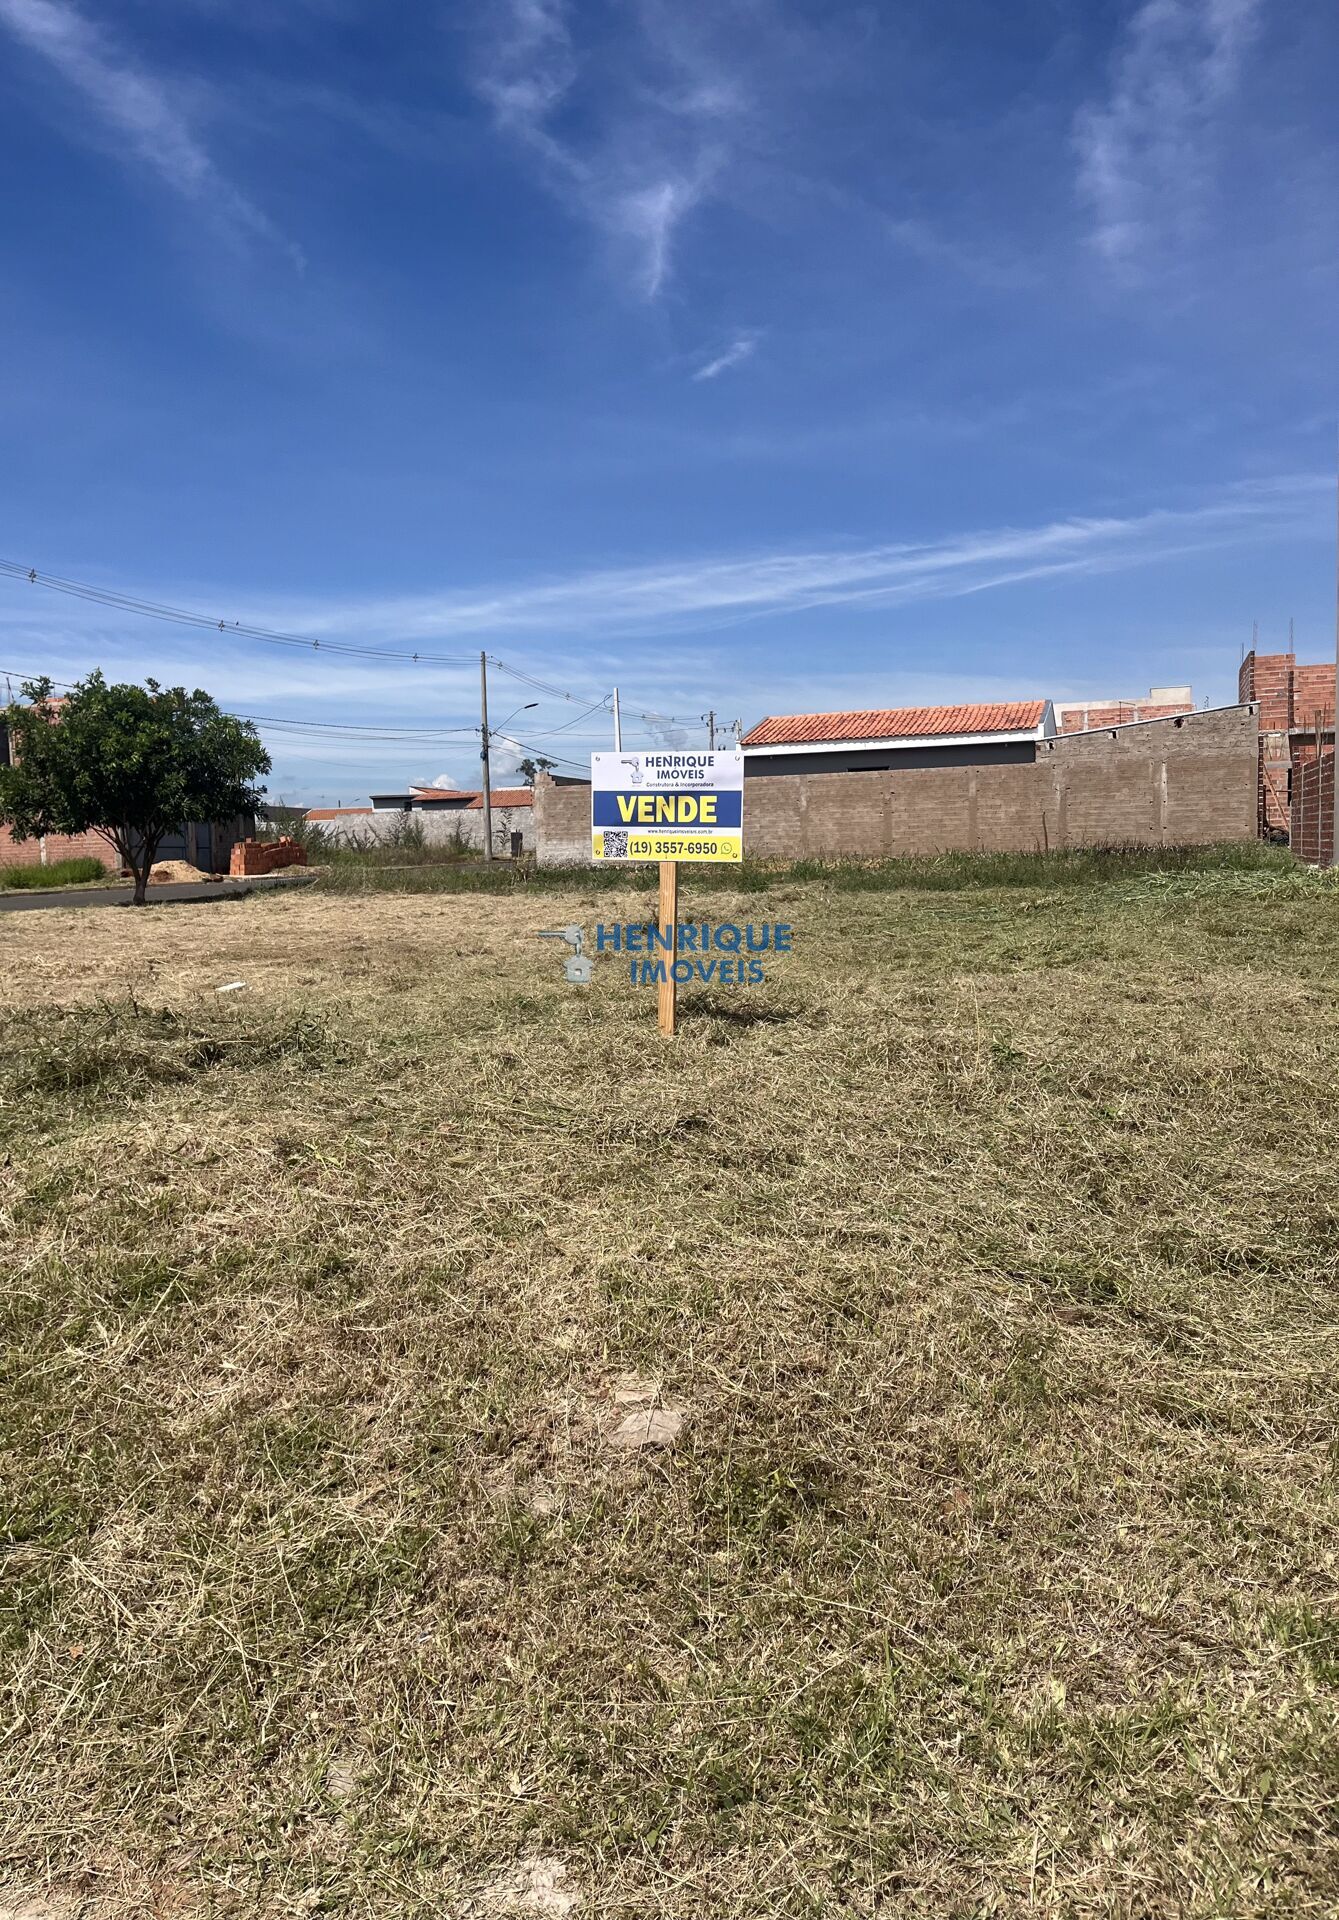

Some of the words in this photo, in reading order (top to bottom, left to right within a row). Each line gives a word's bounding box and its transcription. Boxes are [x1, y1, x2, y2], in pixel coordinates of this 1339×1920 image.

[645, 755, 715, 768] HENRIQUE
[616, 795, 718, 823] VENDE
[629, 841, 652, 856] (19)
[655, 841, 718, 855] 3557-6950
